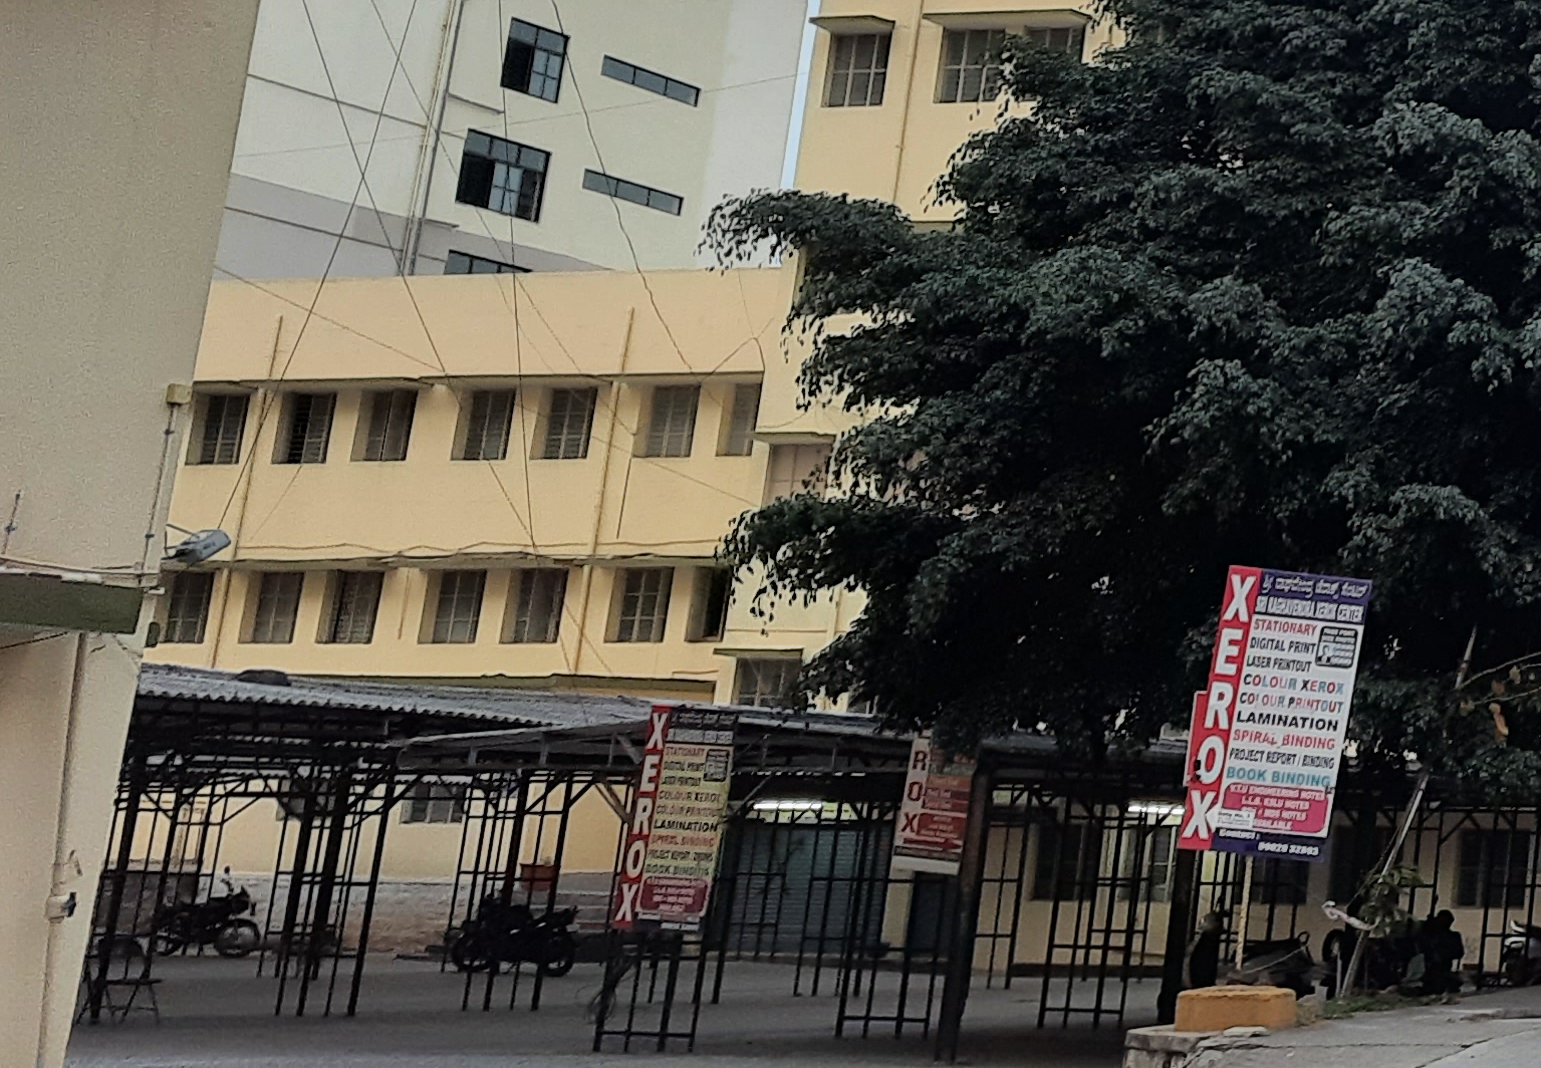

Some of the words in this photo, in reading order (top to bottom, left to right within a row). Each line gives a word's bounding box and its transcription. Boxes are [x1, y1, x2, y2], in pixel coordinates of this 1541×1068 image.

[1254, 619, 1318, 636] STATIONARY
[1250, 636, 1286, 652] DIGITAL
[1288, 640, 1316, 655] PRINT
[1272, 657, 1312, 672] PRINTOUT
[1243, 673, 1297, 691] COLOUR
[1300, 679, 1344, 695] XEROX
[1182, 573, 1256, 839] XEROX
[1288, 696, 1344, 714] PRINTOUT
[1237, 711, 1338, 732] LAMINATION
[1233, 729, 1278, 746] SPIRAL
[1281, 733, 1336, 750] BINDING
[1229, 747, 1265, 762] PROJECT
[1266, 750, 1297, 765] REPORT
[1226, 766, 1267, 782] BOOK
[1271, 770, 1331, 787] BINDING
[615, 713, 668, 921] XEROX
[653, 819, 719, 832] LAMINATION
